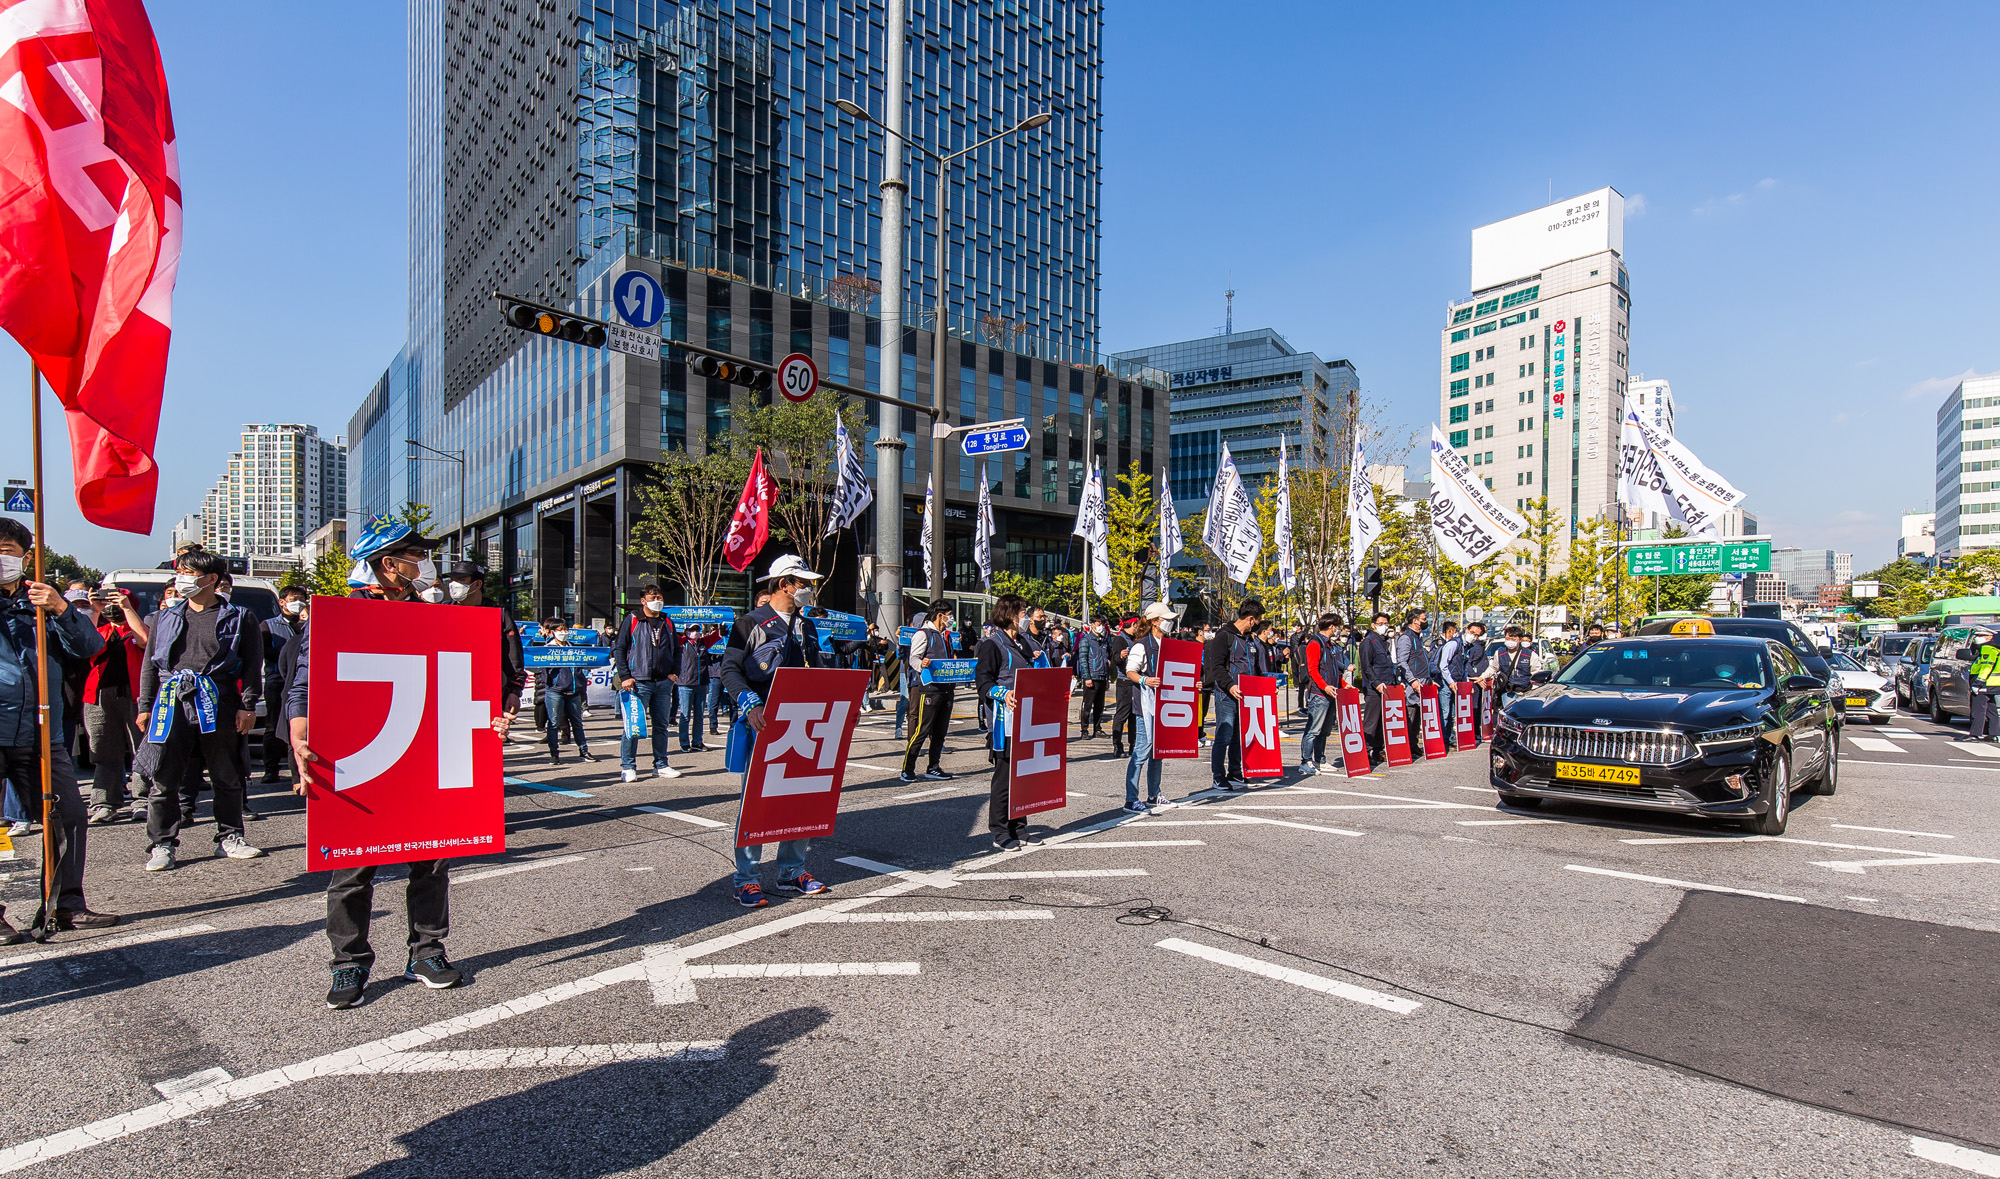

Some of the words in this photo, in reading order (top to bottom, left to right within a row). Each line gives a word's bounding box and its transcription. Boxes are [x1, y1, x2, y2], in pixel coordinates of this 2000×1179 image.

[1566, 200, 1600, 216] 광고문의
[1548, 210, 1600, 232] 010-2312-2397
[610, 326, 660, 349] 좌회전신호시
[613, 338, 655, 358] 보행신호시
[786, 365, 810, 392] 50
[1173, 366, 1232, 386] 적십자병원
[967, 440, 978, 448] 128
[983, 443, 1008, 451] Tongil-ro
[984, 432, 1007, 444] 통일로
[1013, 434, 1024, 442] 124
[1444, 448, 1471, 474] 민주노총
[1439, 453, 1520, 532] 전국서비스산업노동조합연맹
[1635, 551, 1661, 560] 독립문
[1731, 547, 1760, 556] 서울역
[818, 620, 850, 628] 가전노동자도
[942, 661, 969, 669] 가전노동자의
[1160, 660, 1196, 728] 동
[1422, 697, 1441, 740] 권
[1457, 694, 1473, 732] 보
[1482, 690, 1492, 725] 장
[334, 651, 491, 790] 가
[1243, 695, 1277, 750] 자
[1341, 703, 1363, 754] 생
[1385, 699, 1407, 746] 존
[1016, 696, 1061, 777] 노
[761, 700, 852, 798] 전
[1598, 768, 1634, 782] 4749
[332, 846, 363, 858] 민주노총
[365, 842, 402, 854] 서비스연맹
[403, 835, 493, 851] 전국가전통신서비스노동조합
